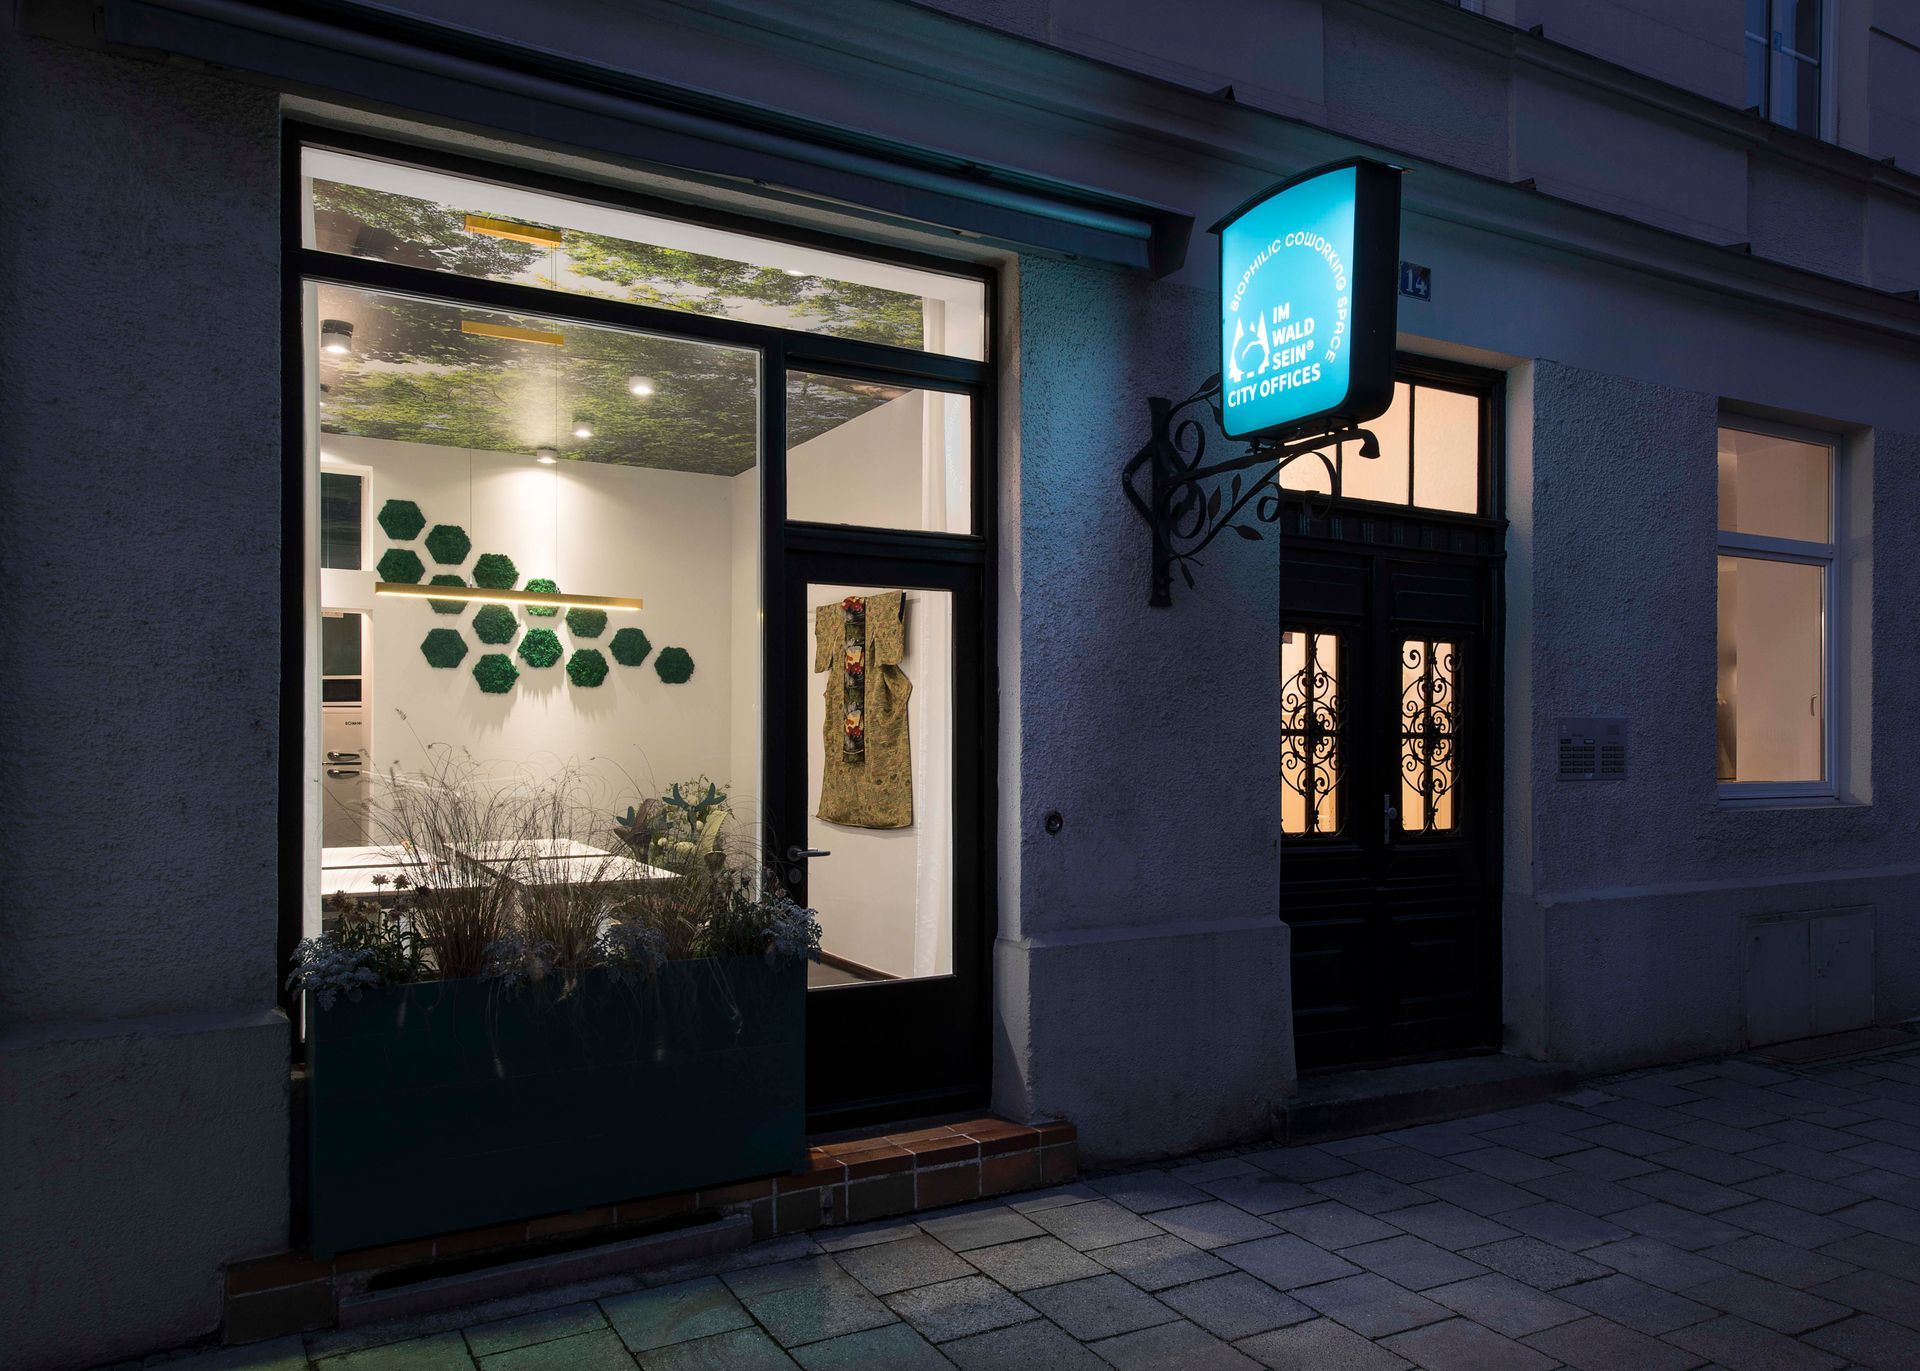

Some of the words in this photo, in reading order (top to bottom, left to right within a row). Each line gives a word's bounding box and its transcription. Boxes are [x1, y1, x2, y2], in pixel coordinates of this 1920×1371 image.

[1230, 239, 1281, 312] BIOPHILIC
[1285, 231, 1347, 291] COWORKING
[1325, 296, 1348, 363] SPACE
[1406, 268, 1426, 296] 14
[1272, 302, 1290, 324] IM
[1272, 317, 1315, 347] WALD
[1228, 383, 1257, 407] CITY
[1260, 363, 1321, 397] OFFICES
